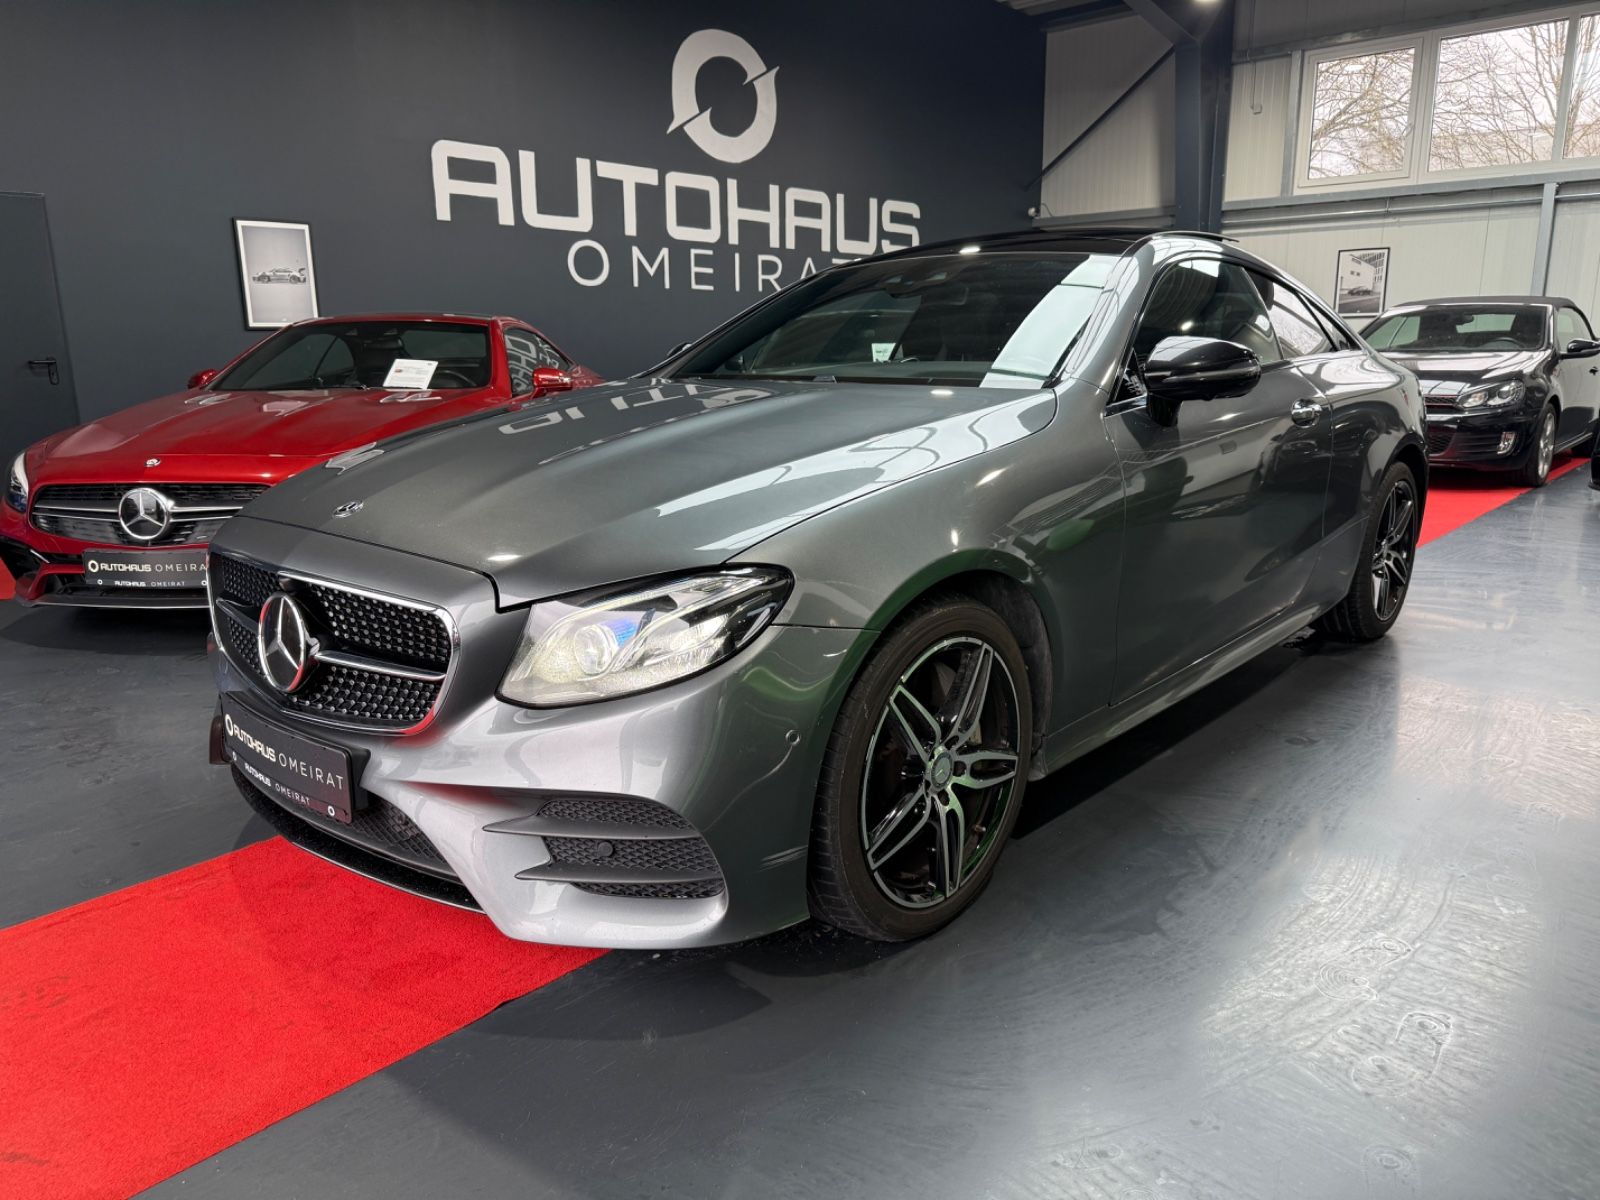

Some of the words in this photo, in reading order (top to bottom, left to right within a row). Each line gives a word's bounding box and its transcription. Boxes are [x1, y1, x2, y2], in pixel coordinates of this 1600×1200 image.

[431, 139, 920, 256] AUTOHAUS
[100, 562, 152, 572] AUTOHAUS
[155, 563, 206, 572] OMEIRA
[233, 723, 277, 763] AUTOHAUS
[278, 753, 344, 791] OMEIRAT
[244, 762, 272, 788] AUTOHAUS
[274, 783, 310, 806] OMEIRAT
